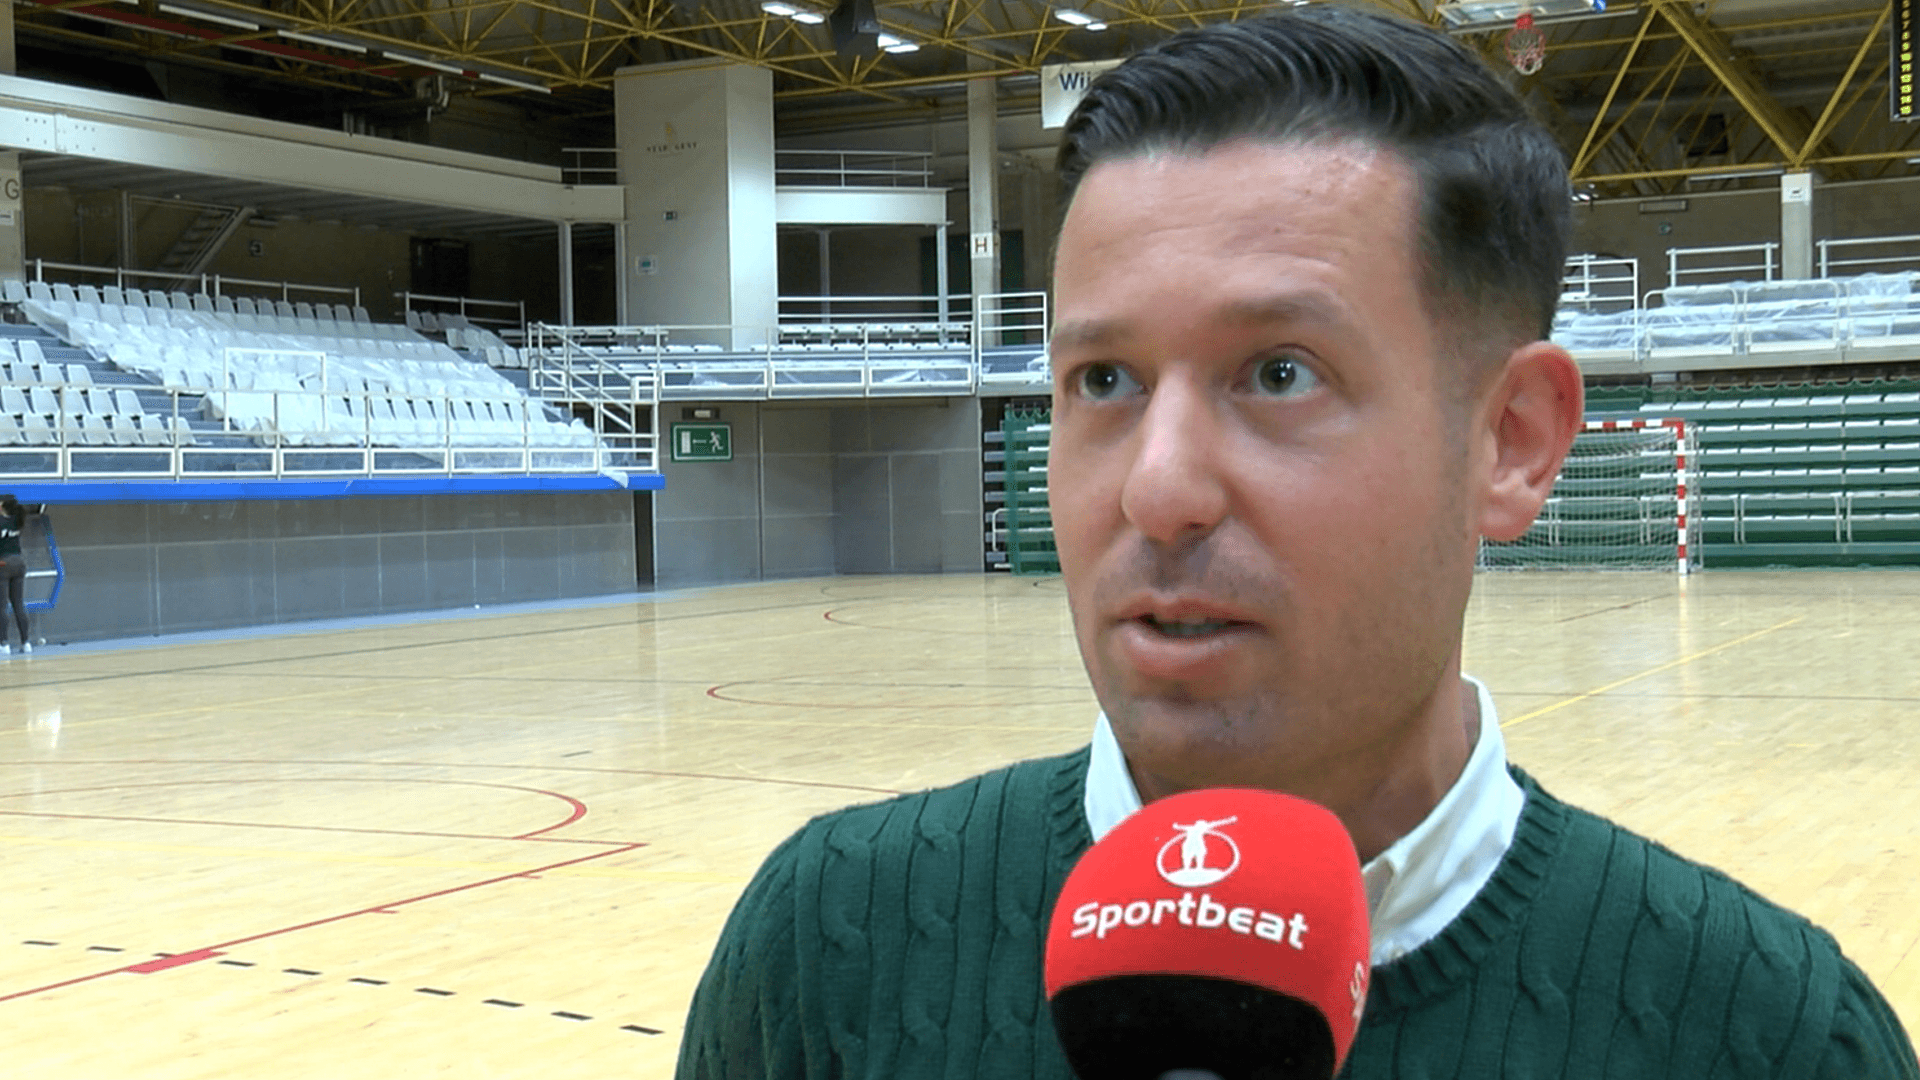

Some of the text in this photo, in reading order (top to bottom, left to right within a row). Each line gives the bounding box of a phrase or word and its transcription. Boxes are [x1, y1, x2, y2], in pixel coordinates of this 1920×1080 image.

[0, 178, 20, 200] G
[975, 236, 988, 253] H
[1071, 892, 1308, 950] Sportbeat
